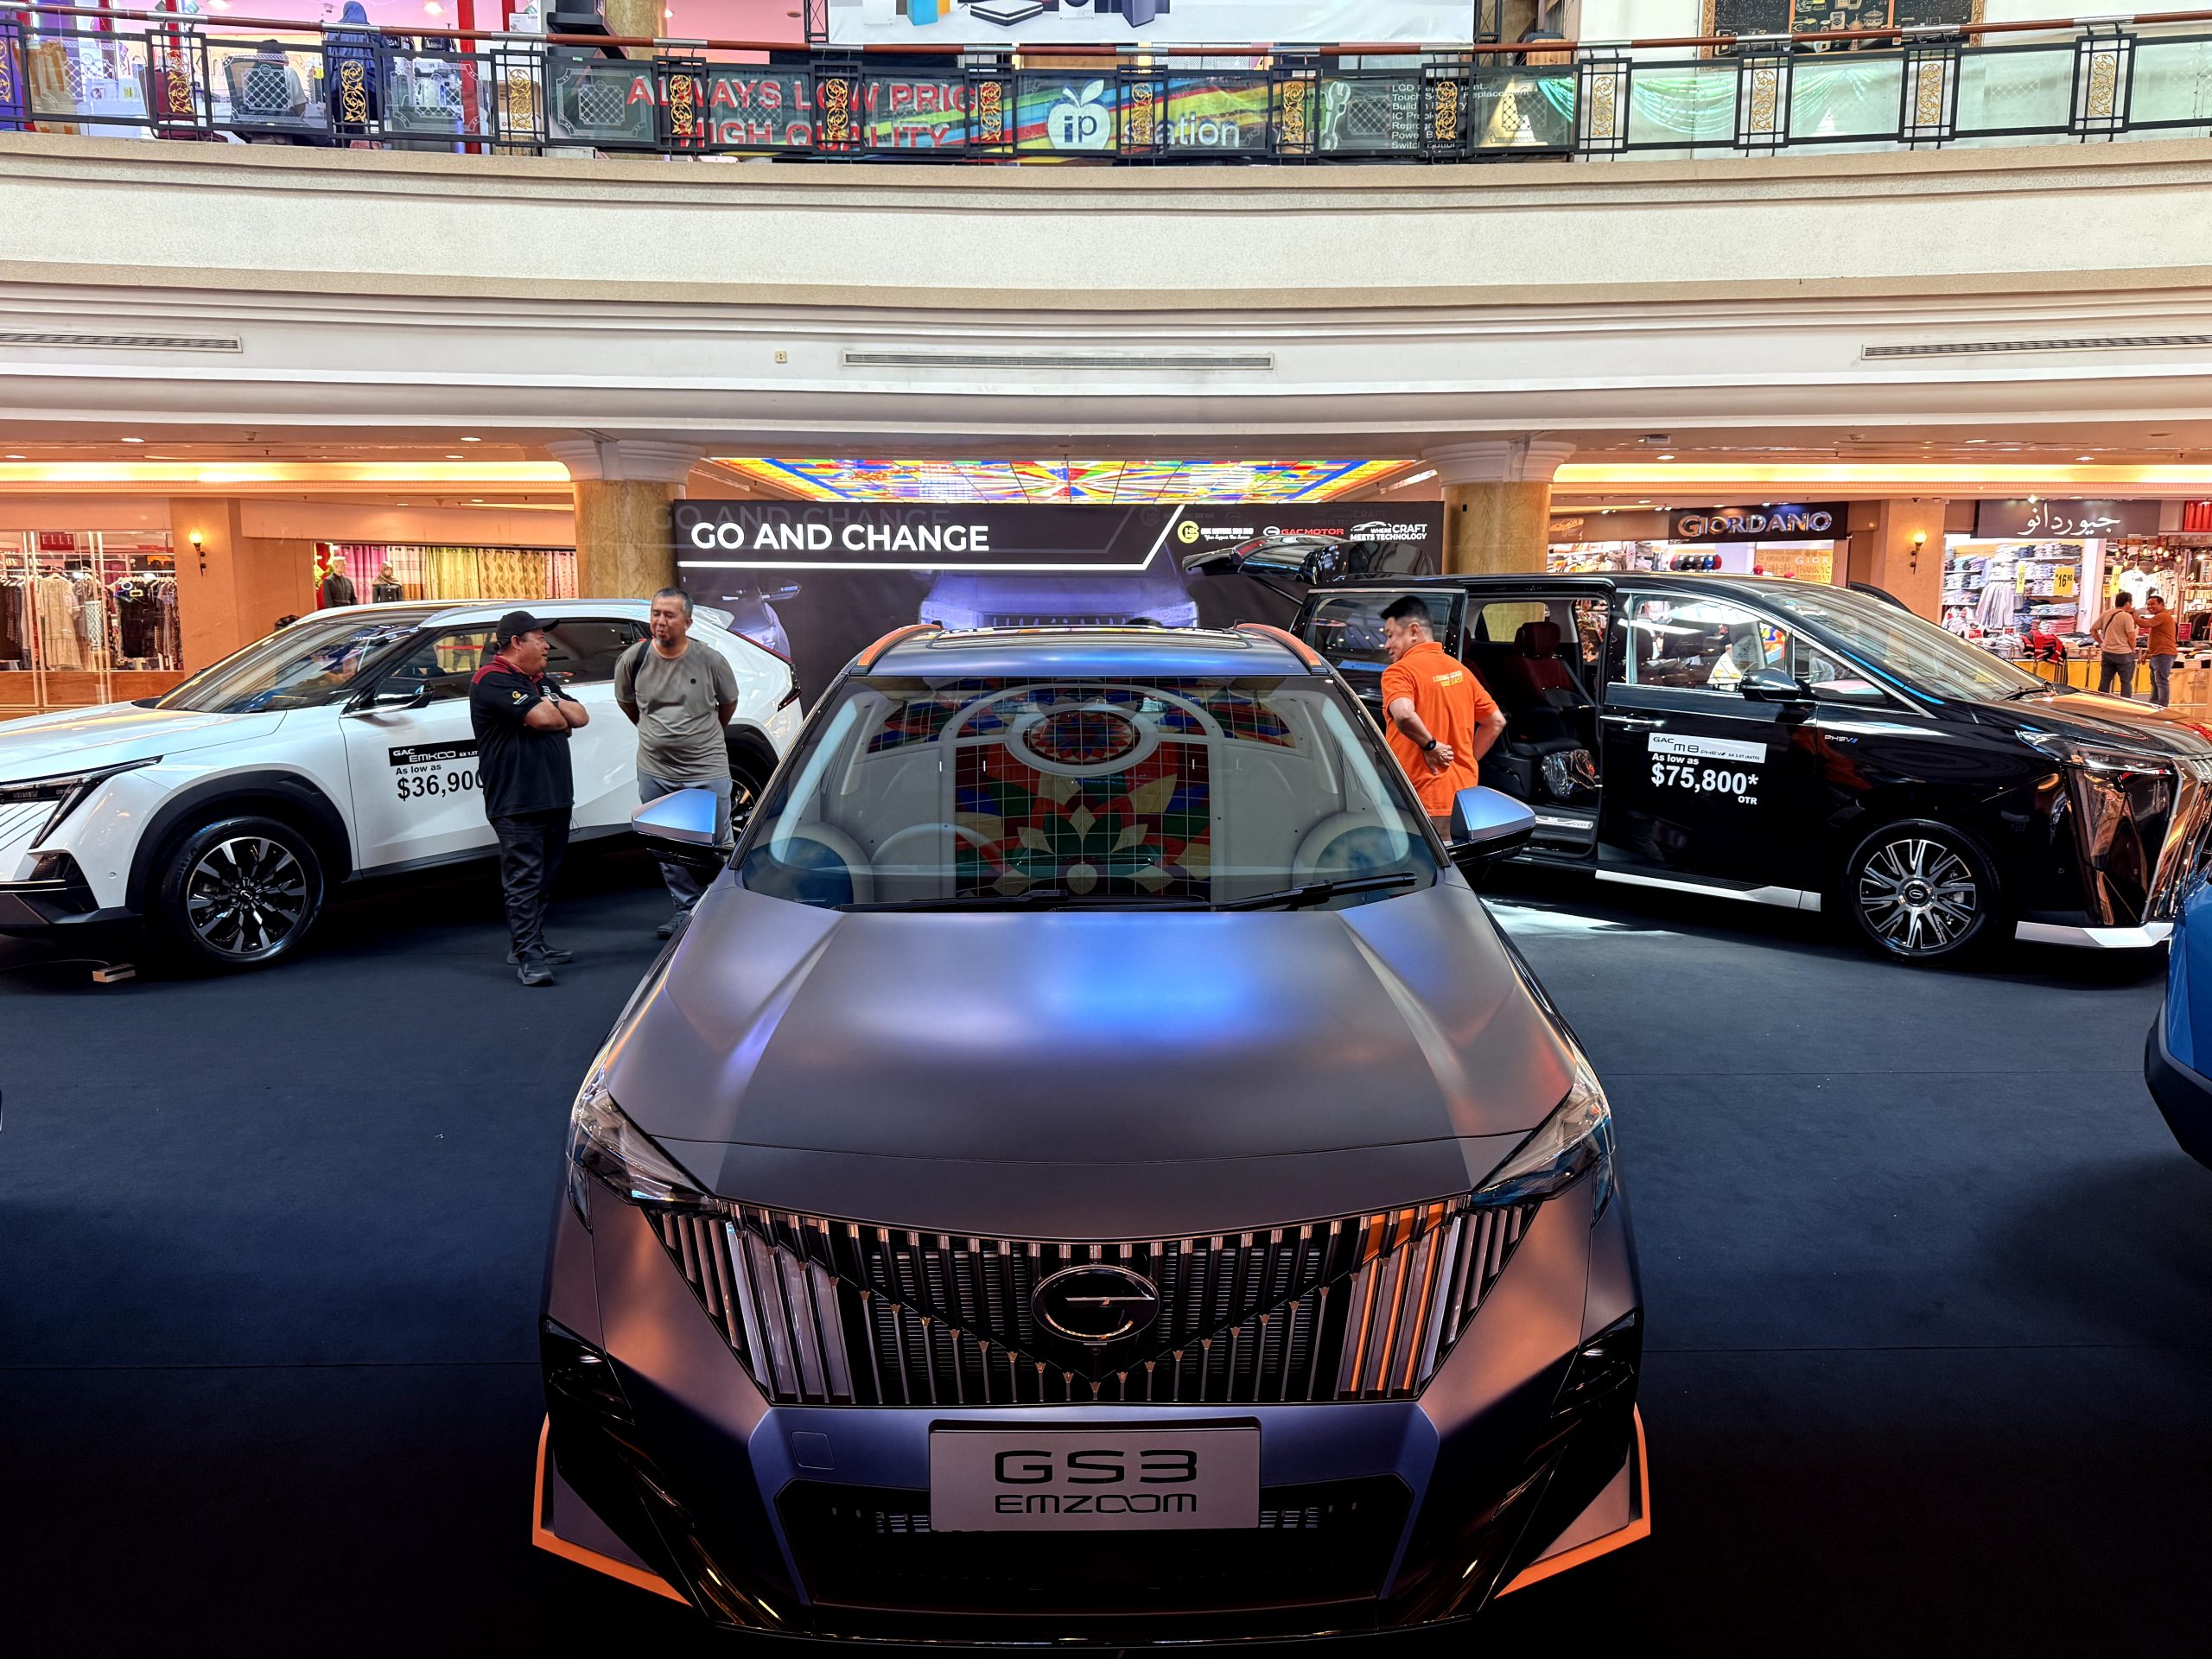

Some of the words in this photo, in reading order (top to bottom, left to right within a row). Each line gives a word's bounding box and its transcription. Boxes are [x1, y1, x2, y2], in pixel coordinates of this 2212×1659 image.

[1392, 84, 1414, 92] LCD
[890, 82, 994, 113] PRIC
[1392, 102, 1417, 111] Build
[1124, 111, 1240, 147] sation
[1678, 511, 1833, 537] GIORDANO
[2017, 502, 2121, 536] جيوردانو
[1392, 524, 1427, 533] CRAFT
[42, 533, 73, 545] ELLE
[691, 522, 745, 550] GO
[753, 523, 833, 550] AND
[842, 524, 989, 551] CHANGE
[1376, 532, 1427, 541] TECHNOLOGY
[392, 748, 416, 757] GAC
[409, 750, 456, 763] EMKOO
[1652, 753, 1665, 762] As
[1667, 753, 1685, 764] low
[1687, 757, 1700, 766] as
[410, 765, 428, 773] low
[1738, 795, 1758, 805] OTR
[995, 1449, 1198, 1484] GS3
[995, 1493, 1198, 1514] EMZOOM
